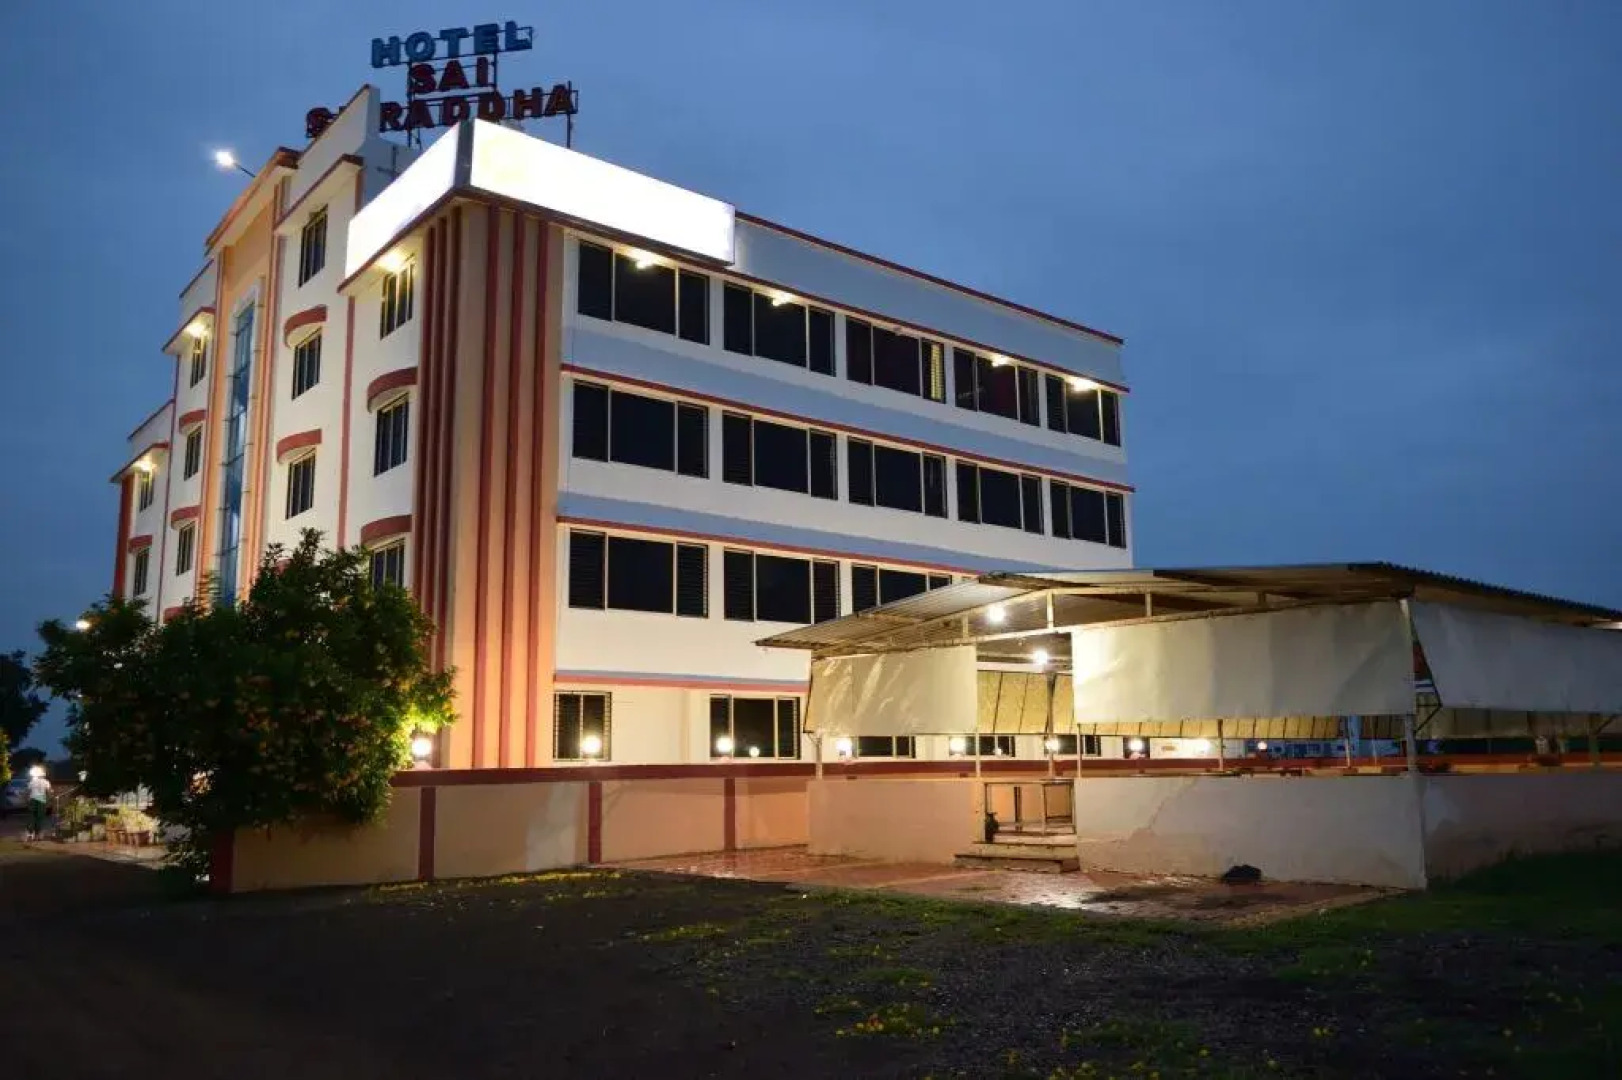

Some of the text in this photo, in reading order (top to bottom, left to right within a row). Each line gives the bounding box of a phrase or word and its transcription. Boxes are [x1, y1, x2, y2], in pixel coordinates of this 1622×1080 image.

[371, 20, 533, 68] HOTEL
[410, 57, 490, 94] SAI
[306, 84, 574, 138] SRADDHA
